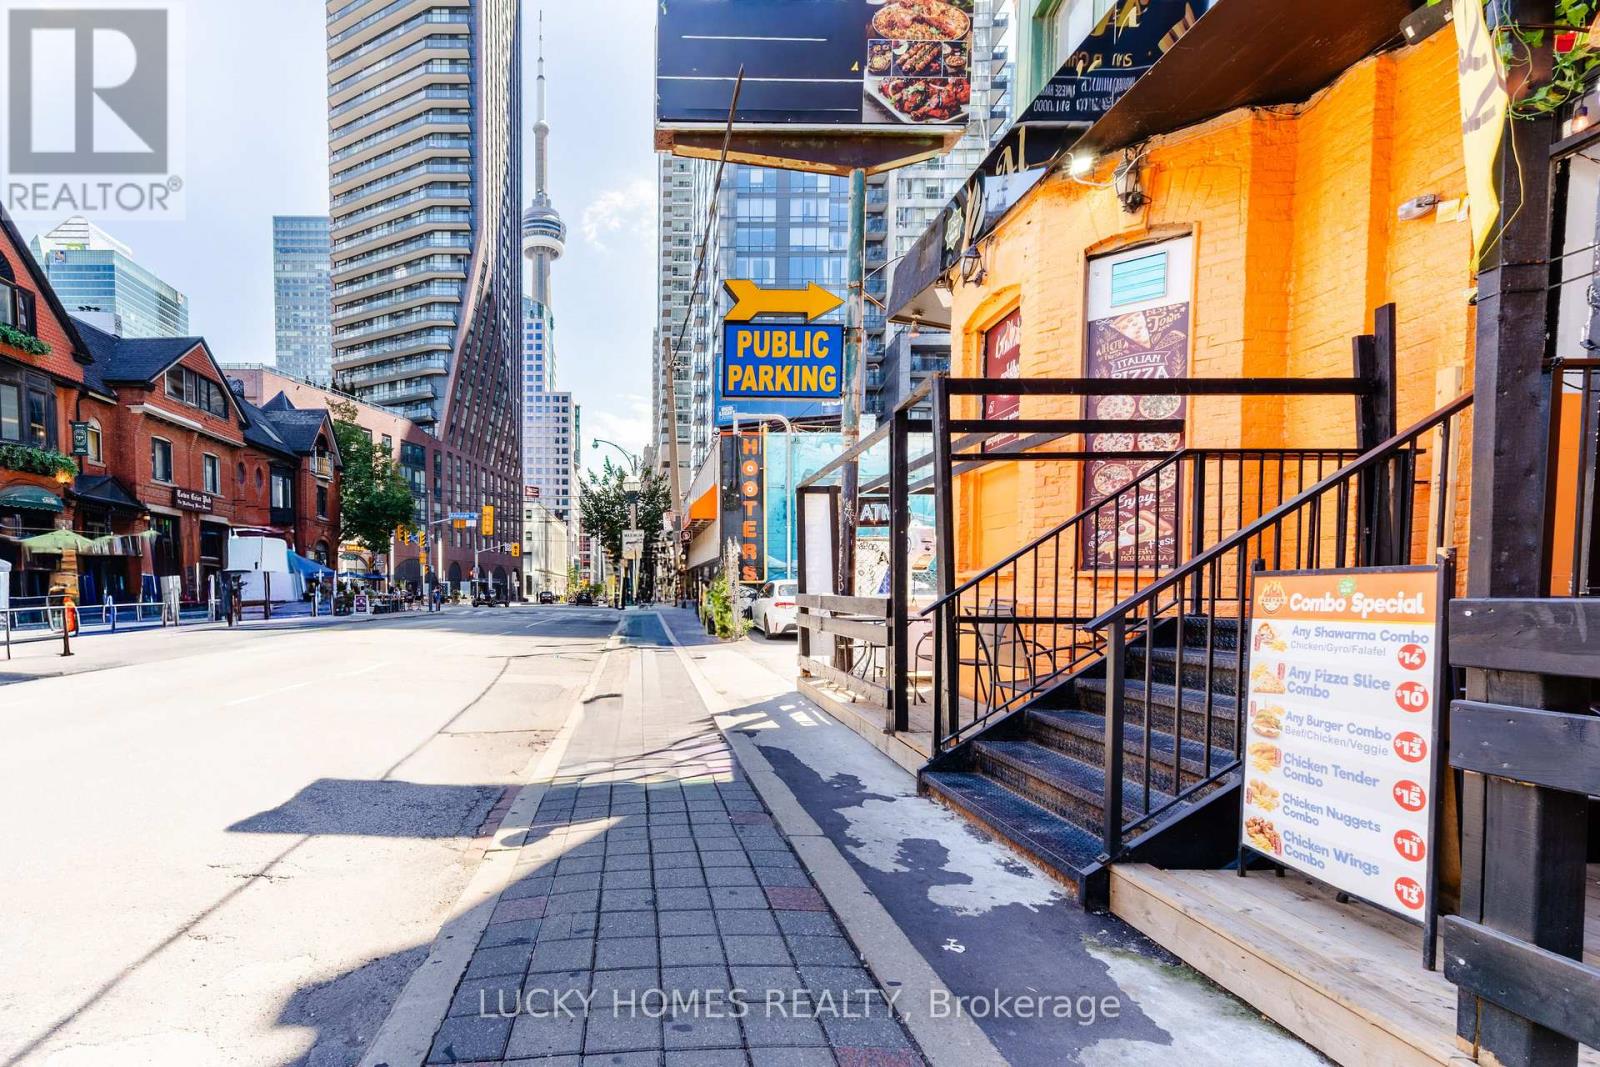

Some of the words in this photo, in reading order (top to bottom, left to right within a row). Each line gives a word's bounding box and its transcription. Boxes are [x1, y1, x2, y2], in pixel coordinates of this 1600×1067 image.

[737, 330, 829, 359] PUBLIC
[1117, 354, 1161, 369] ITALIAN
[727, 364, 837, 392] PARKING
[741, 438, 759, 582] HOOTERS
[1289, 592, 1347, 613] Combo
[1351, 590, 1425, 619] Special
[1292, 625, 1311, 640] Any
[1314, 626, 1376, 641] Shawarma
[1379, 630, 1430, 644] Combo
[1287, 681, 1330, 699] Combo
[1288, 666, 1311, 684] Any
[1315, 669, 1349, 686] Pizza
[1353, 673, 1391, 691] Slice
[1285, 710, 1304, 727] Any
[1306, 714, 1344, 733] Burger
[1347, 722, 1392, 741] Combo
[1283, 752, 1328, 775] Chicken
[1332, 764, 1380, 787] Tender
[1283, 766, 1324, 788] Combo
[1282, 791, 1324, 815] Chicken
[1326, 805, 1381, 833] Nuggets
[1282, 805, 1319, 826] Combo
[1283, 830, 1330, 857] Chicken
[1333, 848, 1380, 877] Wings
[1284, 844, 1325, 870] Combo
